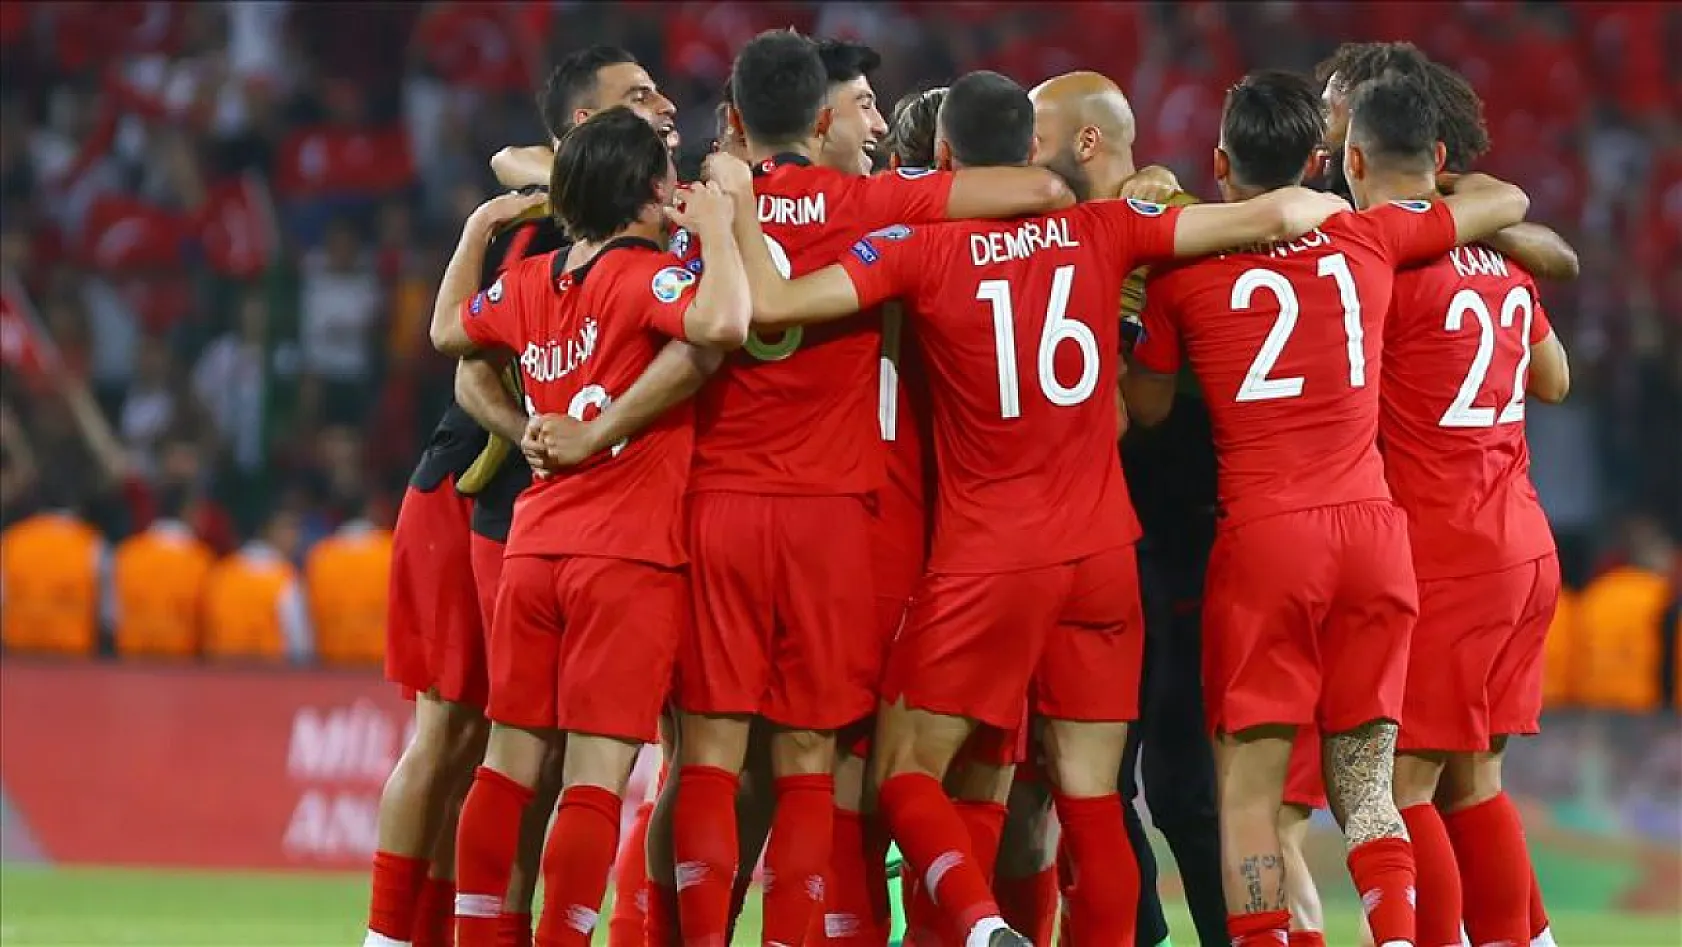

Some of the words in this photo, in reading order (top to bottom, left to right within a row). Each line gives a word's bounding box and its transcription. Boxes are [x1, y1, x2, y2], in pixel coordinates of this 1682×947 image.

[1231, 253, 1366, 402] 21
[1449, 246, 1509, 277] KAAN
[975, 264, 1100, 420] 16
[1438, 286, 1531, 427] 22
